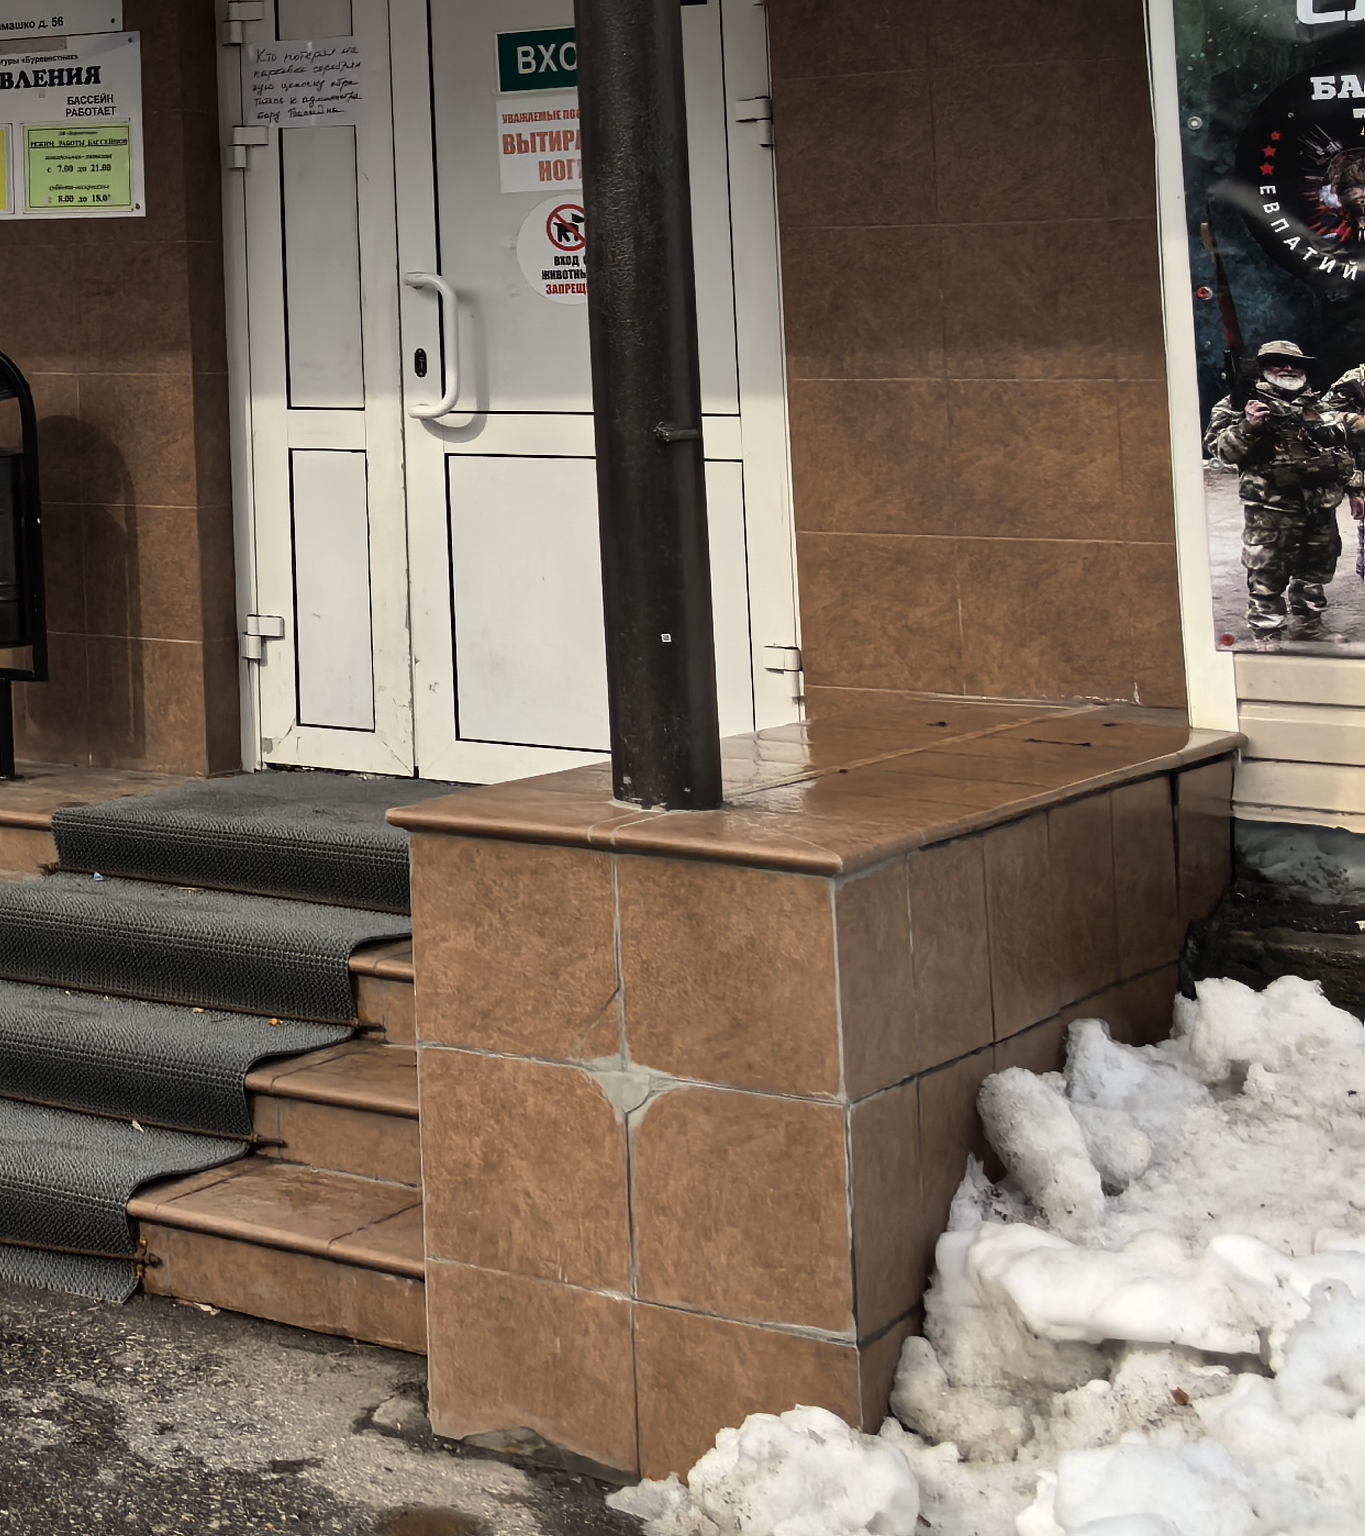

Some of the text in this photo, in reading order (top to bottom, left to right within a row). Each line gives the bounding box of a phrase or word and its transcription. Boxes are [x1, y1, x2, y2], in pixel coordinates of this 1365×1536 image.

[38, 19, 48, 30] д.
[256, 48, 277, 63] Кто
[517, 43, 577, 75] ВХО
[67, 93, 114, 105] БАССЕЙН
[66, 106, 116, 117] РАБОТАЕТ
[502, 110, 561, 124] УВАЖАЕМЫЕ
[1259, 185, 1358, 280] ЕВПАТИЙ
[554, 255, 579, 267] ВХОД
[546, 283, 586, 296] ЗАПРЕЩ
